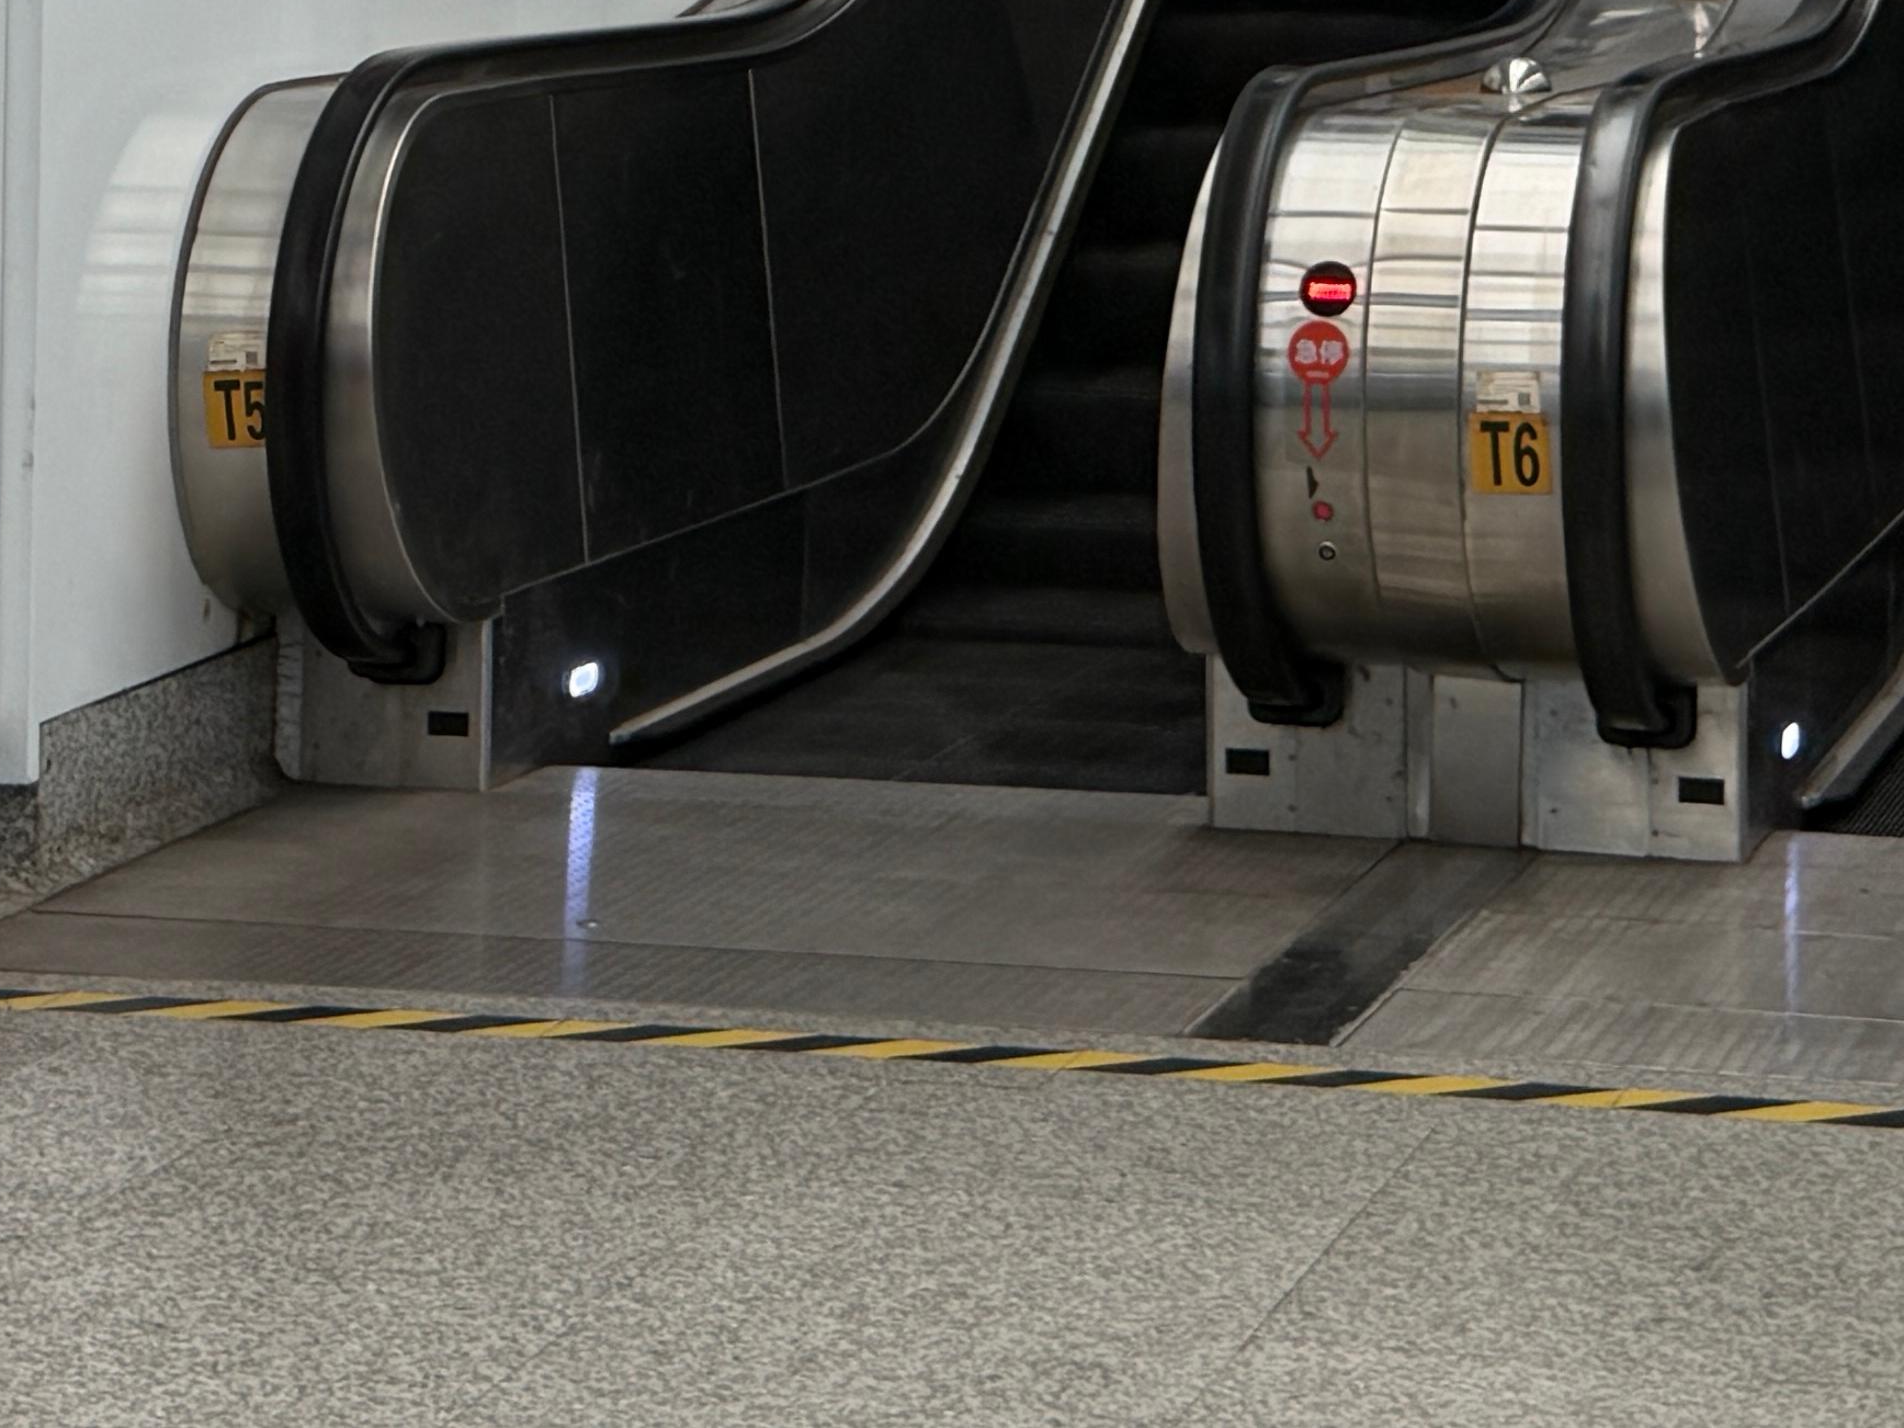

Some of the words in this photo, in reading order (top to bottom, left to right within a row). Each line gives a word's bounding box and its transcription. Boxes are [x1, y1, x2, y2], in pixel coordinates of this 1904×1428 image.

[1294, 338, 1345, 366] 急停
[213, 378, 266, 442] T5
[1479, 420, 1541, 487] T6
